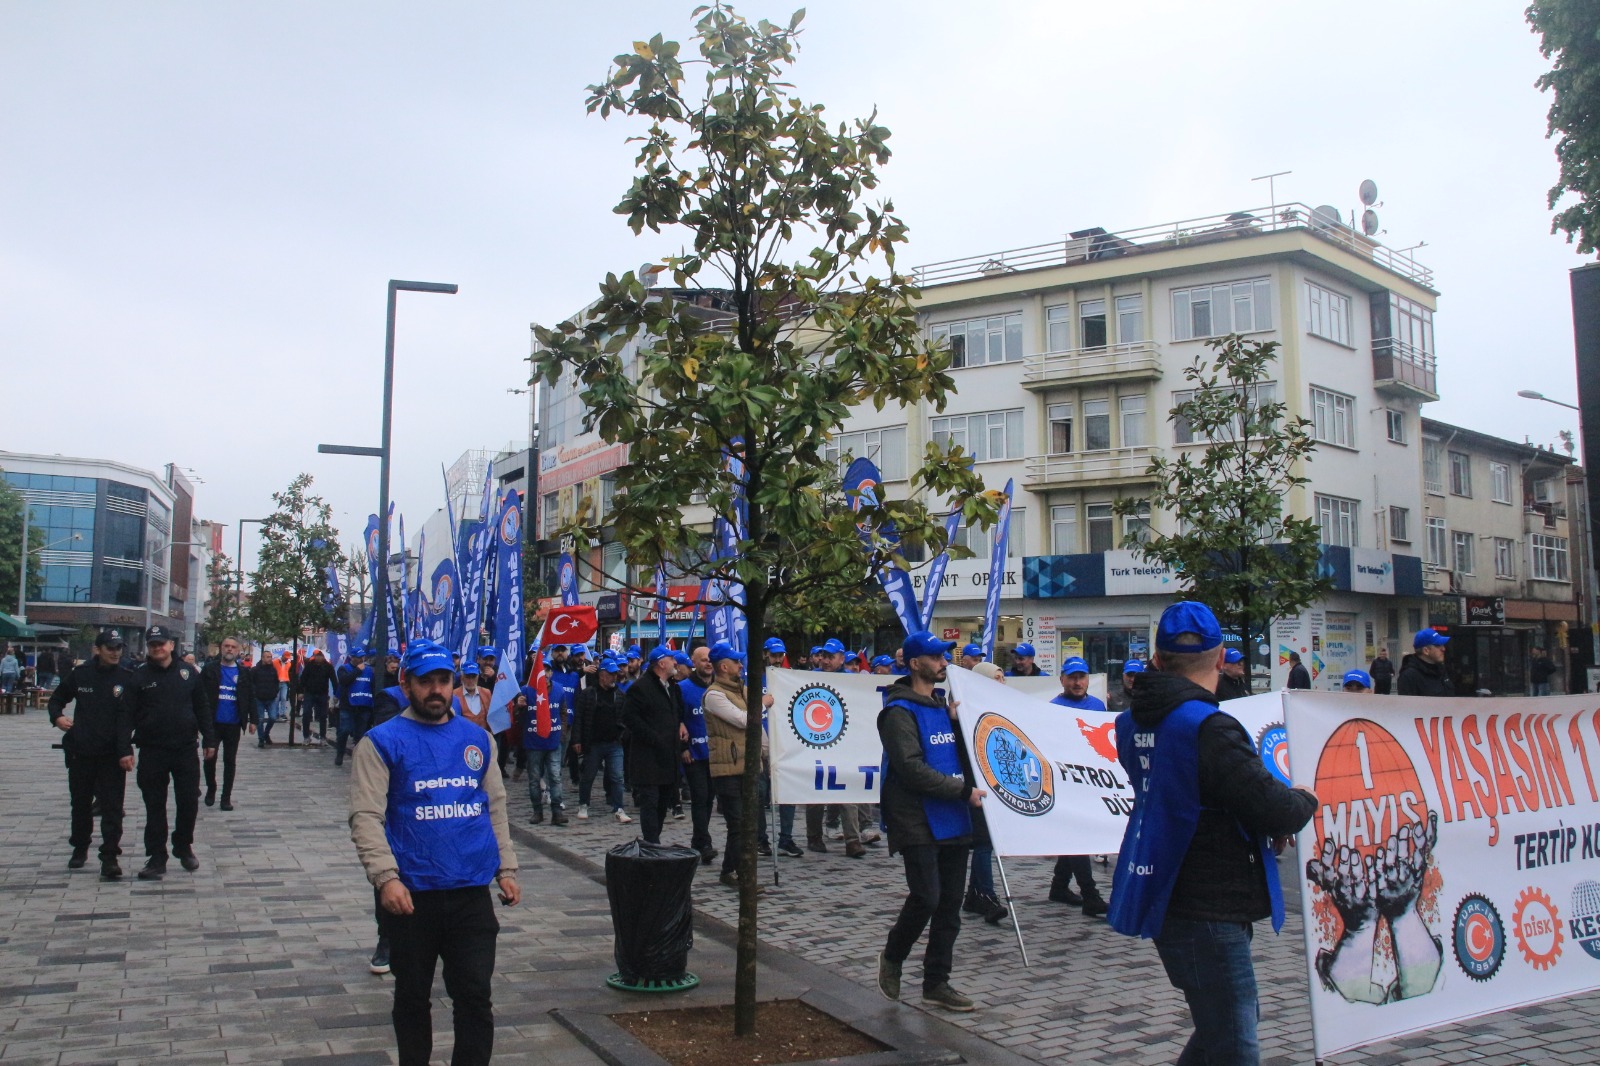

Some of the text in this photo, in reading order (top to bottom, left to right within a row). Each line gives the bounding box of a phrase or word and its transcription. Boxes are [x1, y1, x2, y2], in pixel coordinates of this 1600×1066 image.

[1111, 566, 1170, 576] Türk Telekom
[809, 732, 832, 741] 1952
[1134, 733, 1155, 748] SEN
[1355, 731, 1375, 790] 1
[414, 775, 478, 793] petrol-iş
[814, 759, 846, 790] İL
[1055, 760, 1126, 790] PETROL
[1414, 712, 1575, 847] YAŞASIN
[1322, 790, 1420, 850] MAYIS
[1513, 819, 1577, 871] TERTİP
[1523, 914, 1552, 938] DİSK
[1470, 956, 1495, 972] 1952
